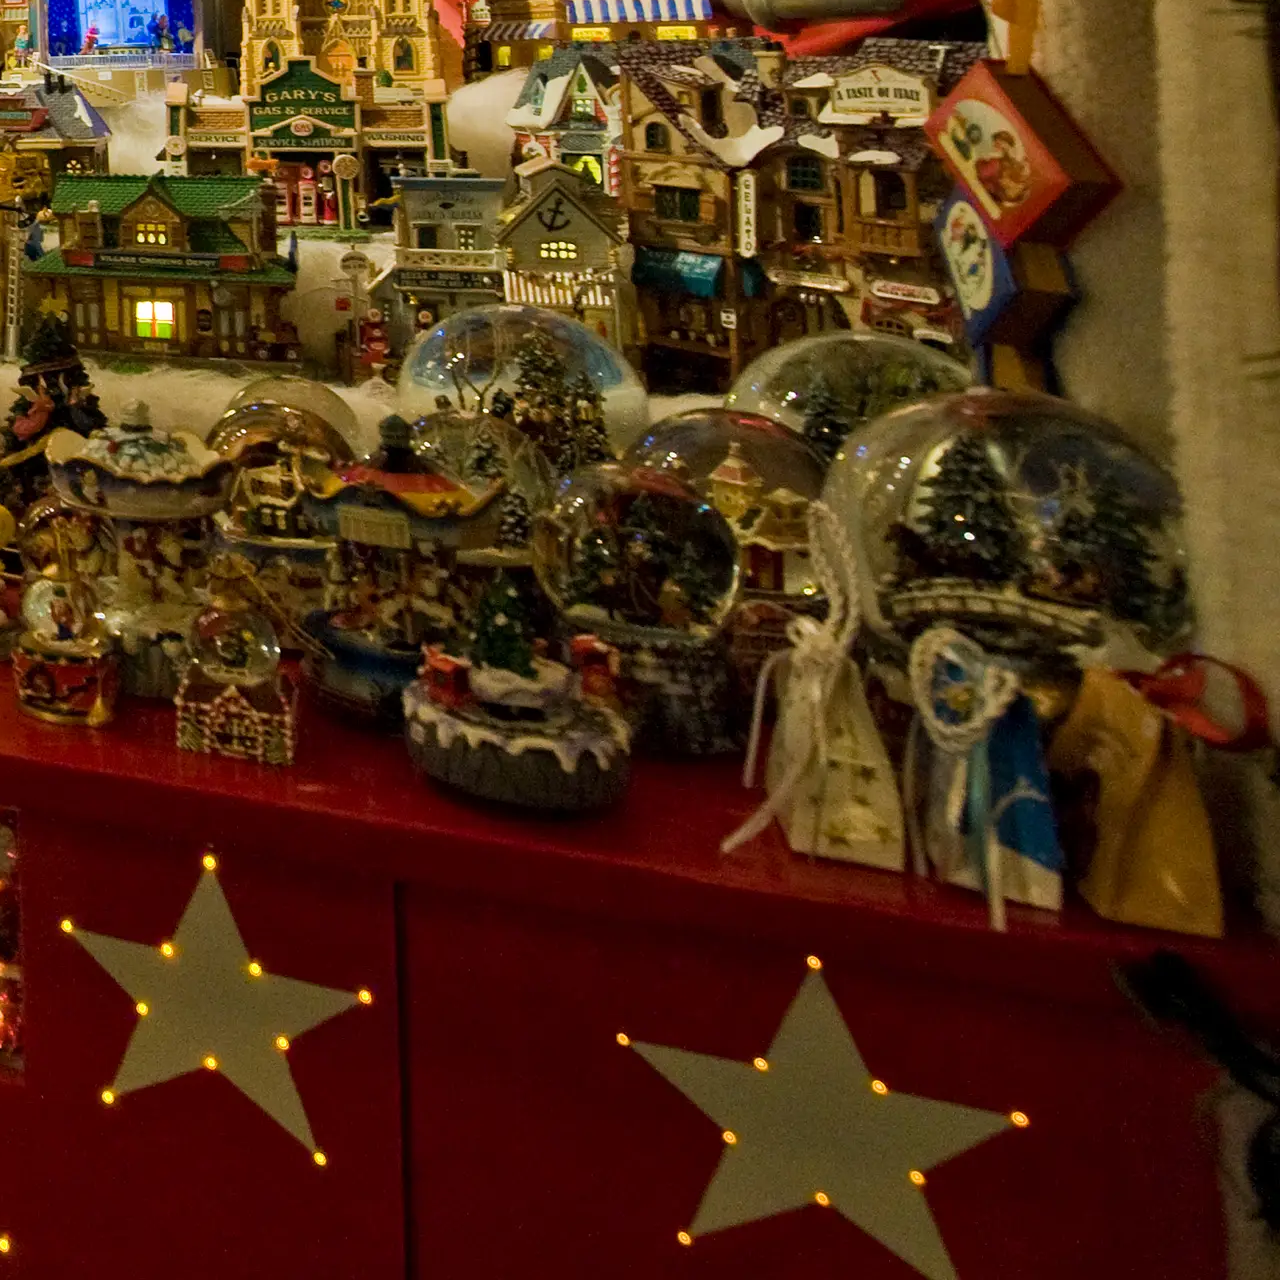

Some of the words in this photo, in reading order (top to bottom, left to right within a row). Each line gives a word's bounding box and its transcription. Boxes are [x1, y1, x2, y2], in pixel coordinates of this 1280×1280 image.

[265, 88, 337, 104] GARY'S
[253, 106, 282, 116] GAS
[285, 107, 293, 116] &
[300, 106, 352, 116] SERVICE
[190, 134, 240, 143] SERVICE
[366, 133, 425, 142] WASHING
[257, 138, 297, 147] SERVICE
[300, 138, 346, 147] STATION
[743, 179, 753, 251] GELATO
